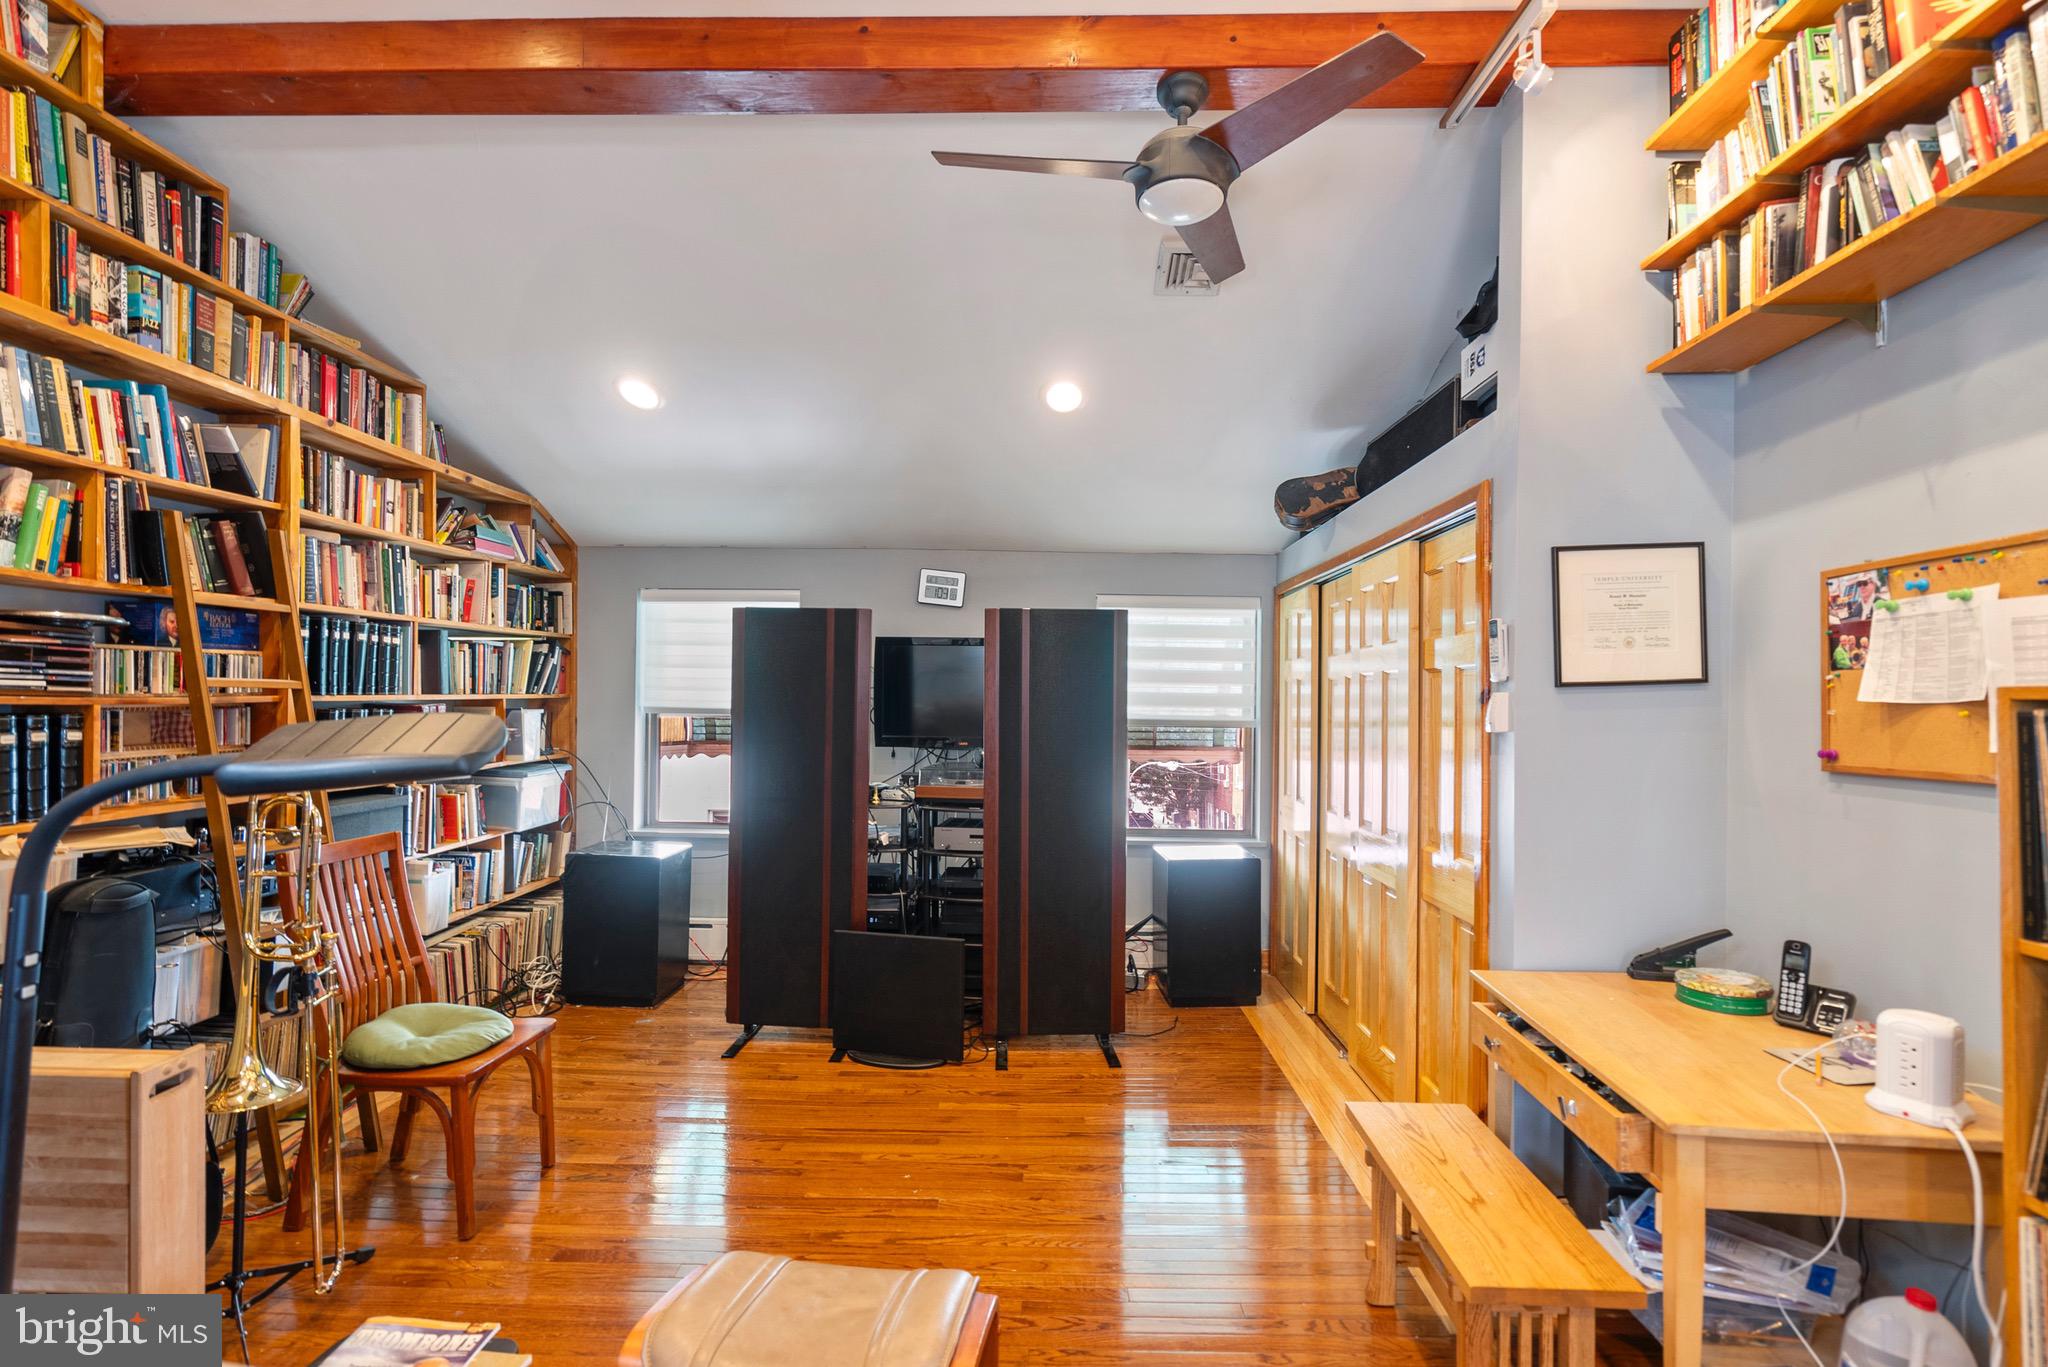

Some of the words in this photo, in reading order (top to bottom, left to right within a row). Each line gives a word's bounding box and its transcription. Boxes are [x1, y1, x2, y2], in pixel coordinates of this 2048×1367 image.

[147, 190, 156, 228] PYTHON
[142, 316, 159, 330] JAZZ
[184, 431, 196, 458] BACH
[209, 613, 231, 623] BACH
[353, 1328, 484, 1351] TROMBONE
